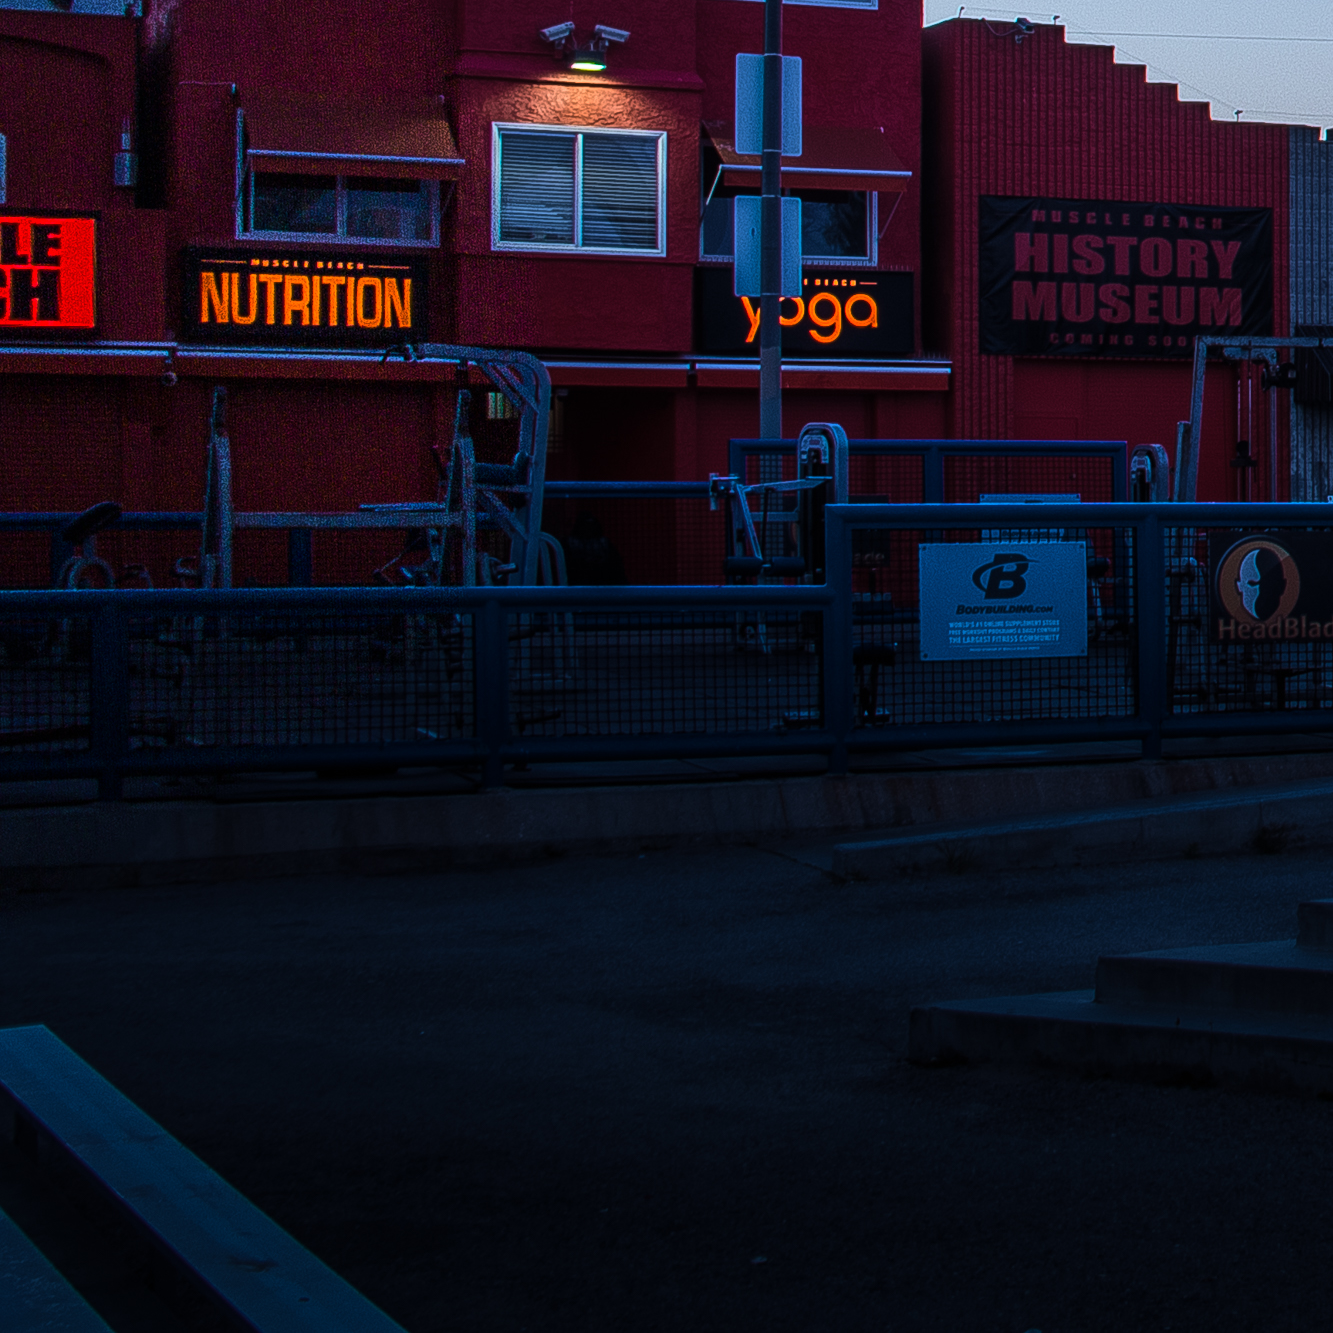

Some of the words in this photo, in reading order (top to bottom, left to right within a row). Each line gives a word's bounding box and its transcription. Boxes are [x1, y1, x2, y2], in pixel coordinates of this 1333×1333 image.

[1031, 209, 1131, 226] MUSCLE
[1143, 214, 1223, 230] BEACH
[1014, 232, 1242, 279] HISTORY
[200, 271, 413, 329] NUTRITION
[1011, 280, 1243, 327] MUSEUM
[1050, 332, 1134, 346] COMING
[1148, 334, 1197, 347] SOO
[962, 635, 991, 644] LARGEST
[992, 635, 1018, 643] FITNESS
[1019, 634, 1060, 643] COMMUNITY
